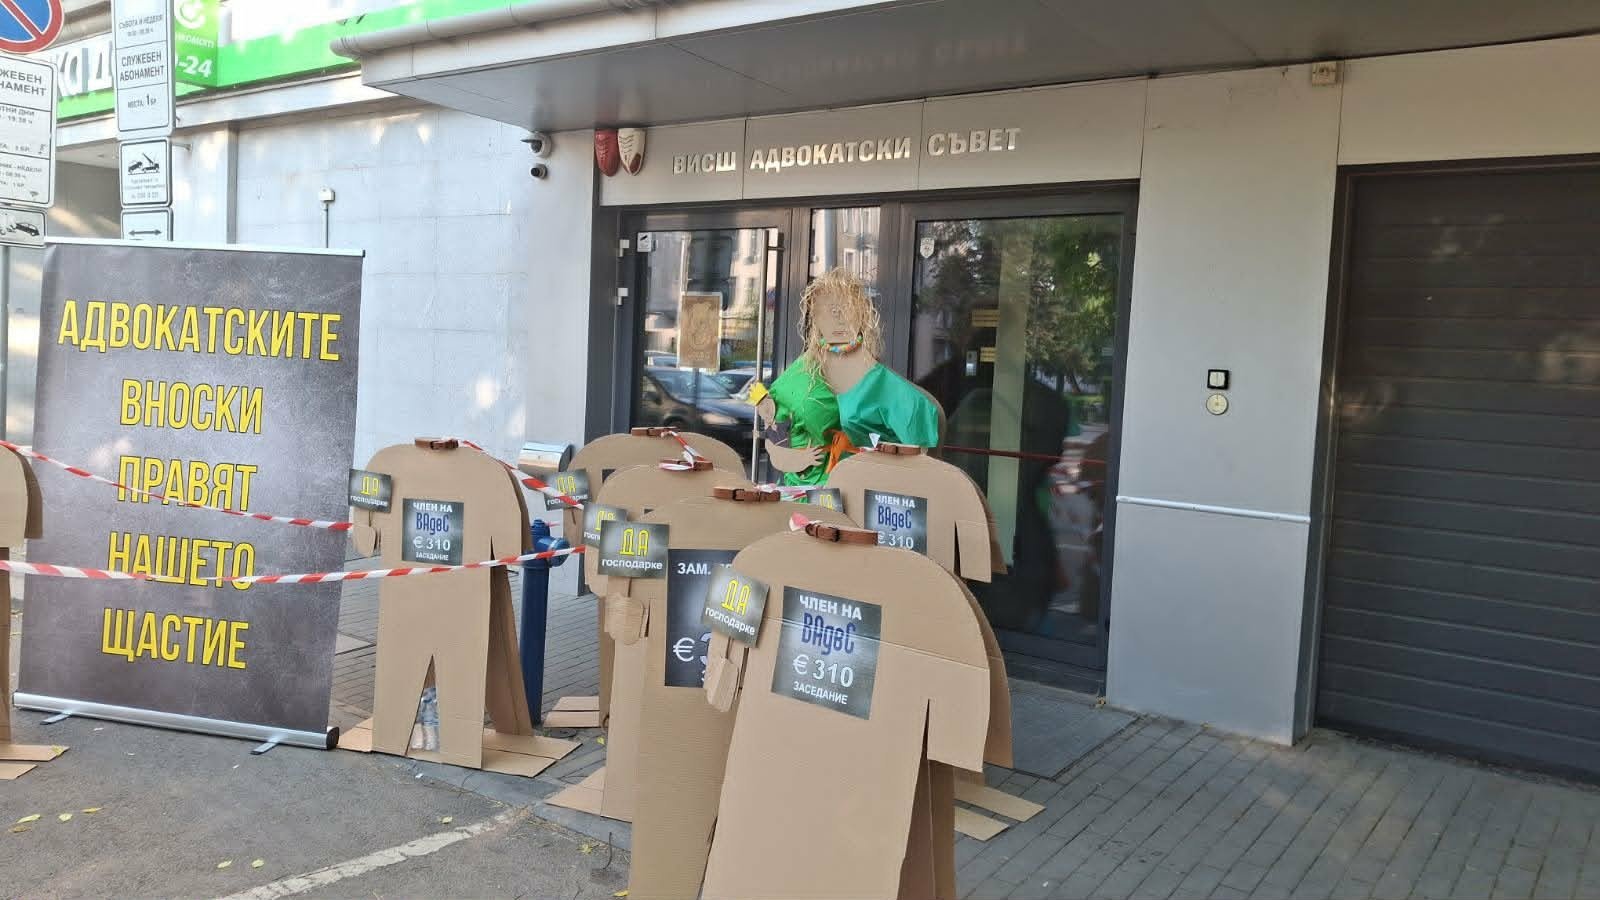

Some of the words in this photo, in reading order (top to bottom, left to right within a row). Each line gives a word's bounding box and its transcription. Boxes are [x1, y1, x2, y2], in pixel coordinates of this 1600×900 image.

[175, 33, 214, 48] нкомат
[121, 51, 162, 67] СЛУЖЕБЕН
[175, 55, 213, 78] -24
[0, 68, 42, 85] ЖЕБЕН
[119, 65, 165, 82] АБОНАМЕНТ
[0, 80, 47, 97] НАМЕНТ
[672, 151, 737, 176] ВИСШ
[749, 137, 912, 174] АДВОКАТСКИ
[926, 127, 1021, 157] СЪВЕТ
[57, 299, 342, 362] АДВОКАТСКИТЕ
[120, 378, 263, 434] ВНОСКИ
[117, 454, 258, 512] ПРАВЯТ
[361, 476, 379, 496] ДА
[413, 501, 437, 512] ЧЛЕН
[440, 503, 453, 512] НА
[875, 494, 900, 505] ЧЛЕН
[902, 498, 916, 508] НА
[426, 538, 451, 551] 310
[619, 527, 650, 556] ДА
[888, 533, 914, 549] 310
[108, 530, 255, 590] НАШЕТО
[415, 551, 449, 561] ЗАСЕДАНИЕ
[601, 558, 663, 572] господарке
[677, 562, 711, 575] ЗАМ.
[721, 578, 751, 616] ДА
[799, 594, 838, 615] ЧЛЕН
[841, 602, 862, 621] НА
[705, 606, 756, 636] господарке
[102, 607, 249, 669] ЩАСТИЕ
[673, 637, 695, 662] €
[793, 653, 809, 675] €
[812, 659, 854, 688] 310
[793, 680, 849, 705] ЗАСЕДАНИЕ
